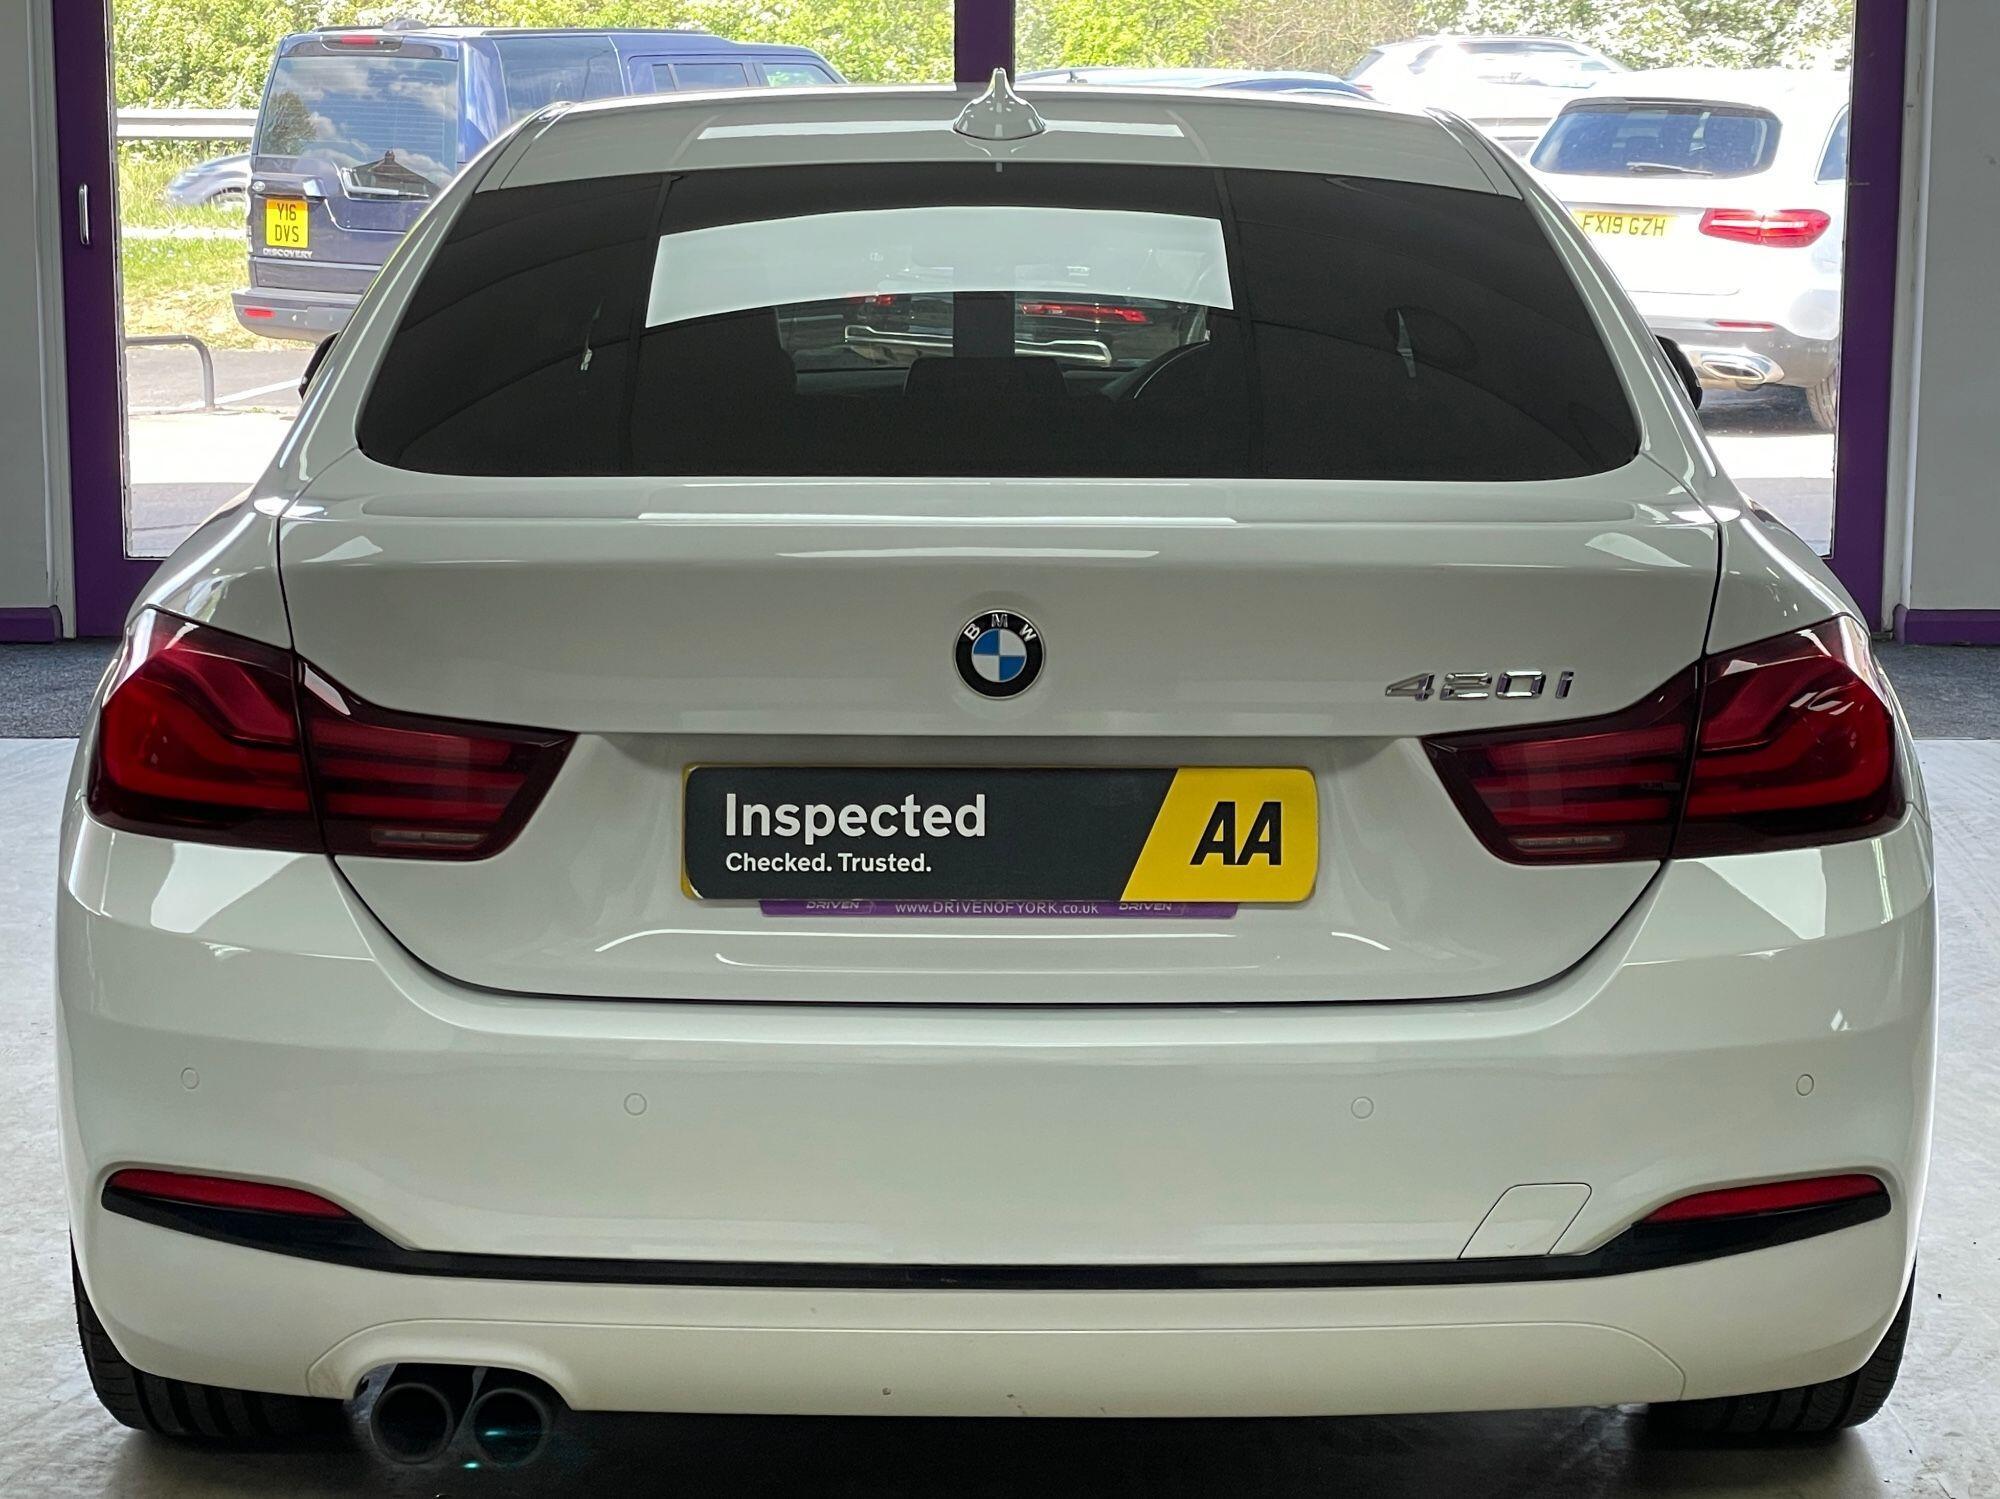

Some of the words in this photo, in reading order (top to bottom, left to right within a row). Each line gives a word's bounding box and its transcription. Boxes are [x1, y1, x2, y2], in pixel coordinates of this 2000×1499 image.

[277, 203, 297, 221] Y16
[275, 224, 299, 242] DVS
[1583, 214, 1623, 234] FX19
[1628, 217, 1666, 236] GZH
[263, 247, 313, 259] DISCOVERY
[963, 613, 1037, 642] BMW
[1385, 670, 1575, 701] 420i
[725, 793, 987, 846] Inspected
[1189, 801, 1282, 866] AA
[725, 852, 832, 872] Checked.
[837, 852, 932, 872] Trusted.
[895, 901, 1100, 914] www.DRIVENOFYORK.co.uk
